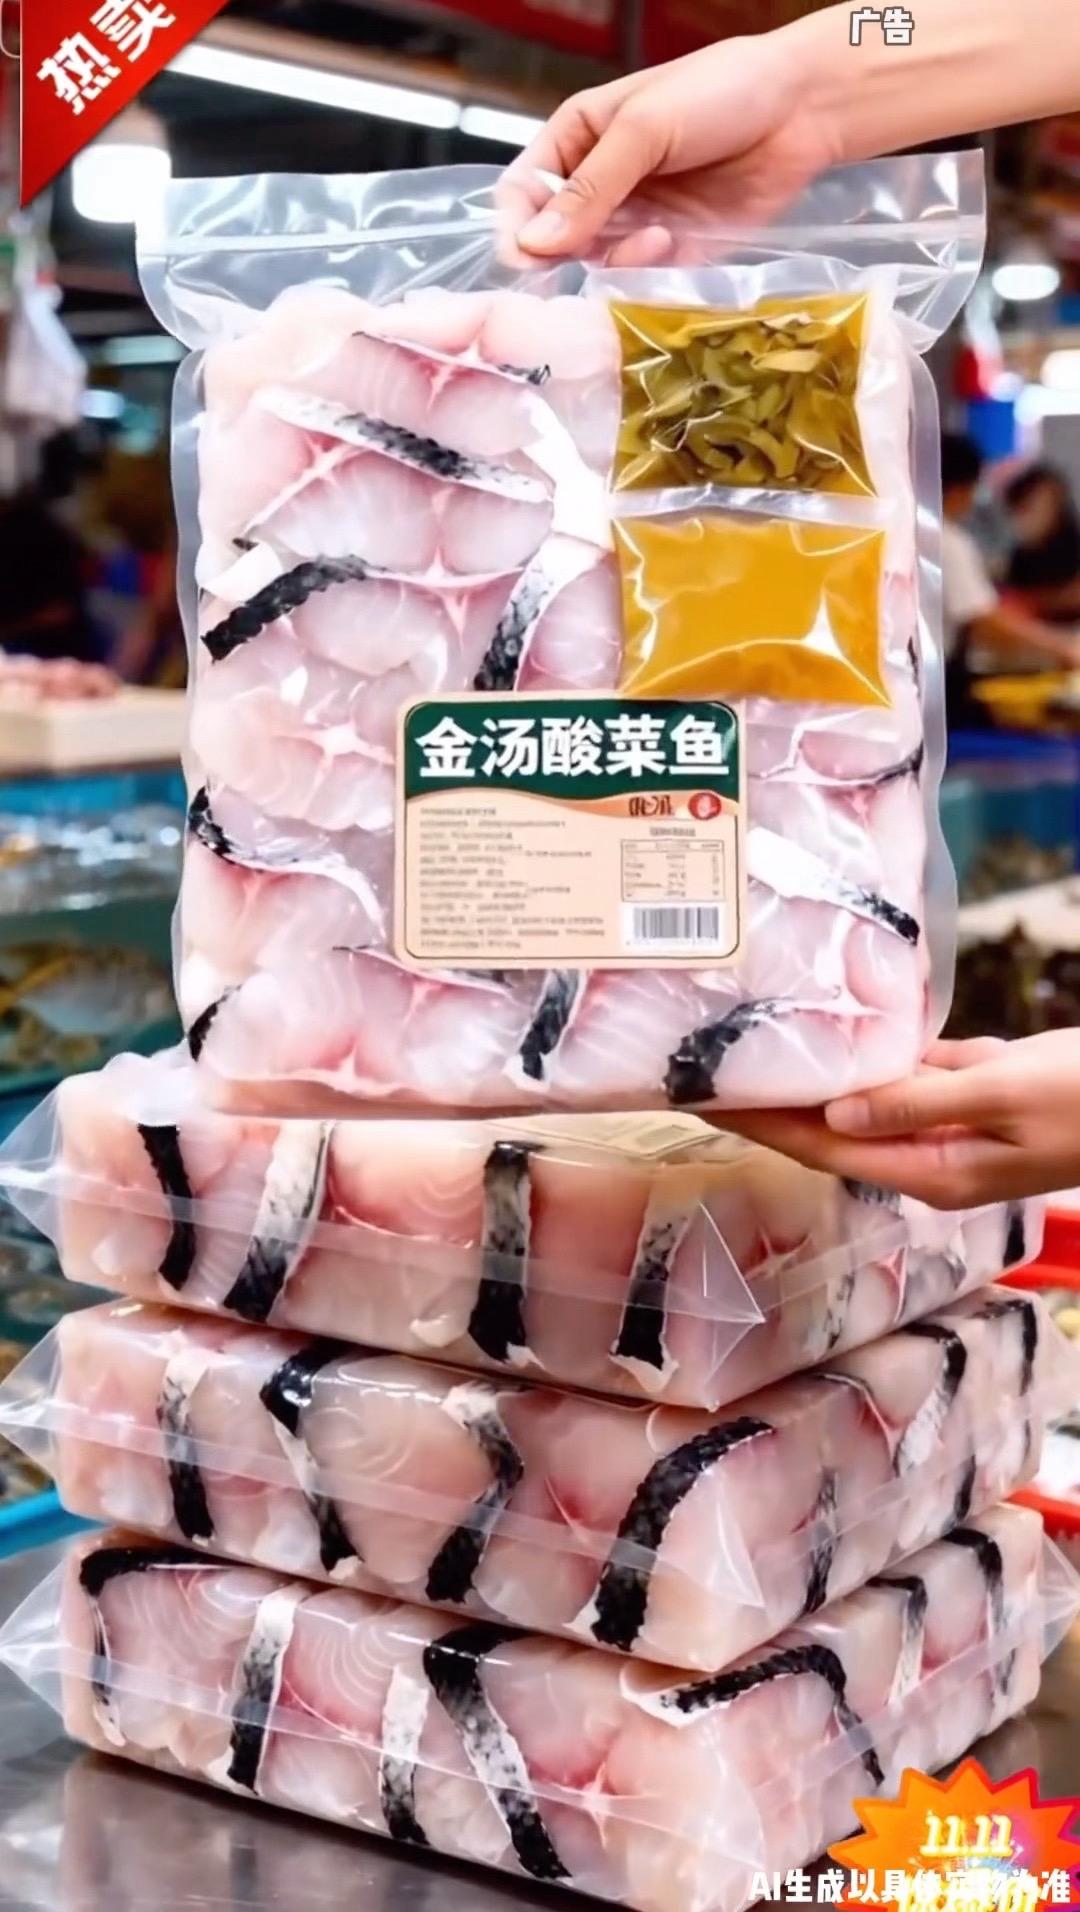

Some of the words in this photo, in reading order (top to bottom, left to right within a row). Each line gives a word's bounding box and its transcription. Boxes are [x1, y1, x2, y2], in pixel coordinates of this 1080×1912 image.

[415, 714, 729, 778] 金汤酸菜鱼
